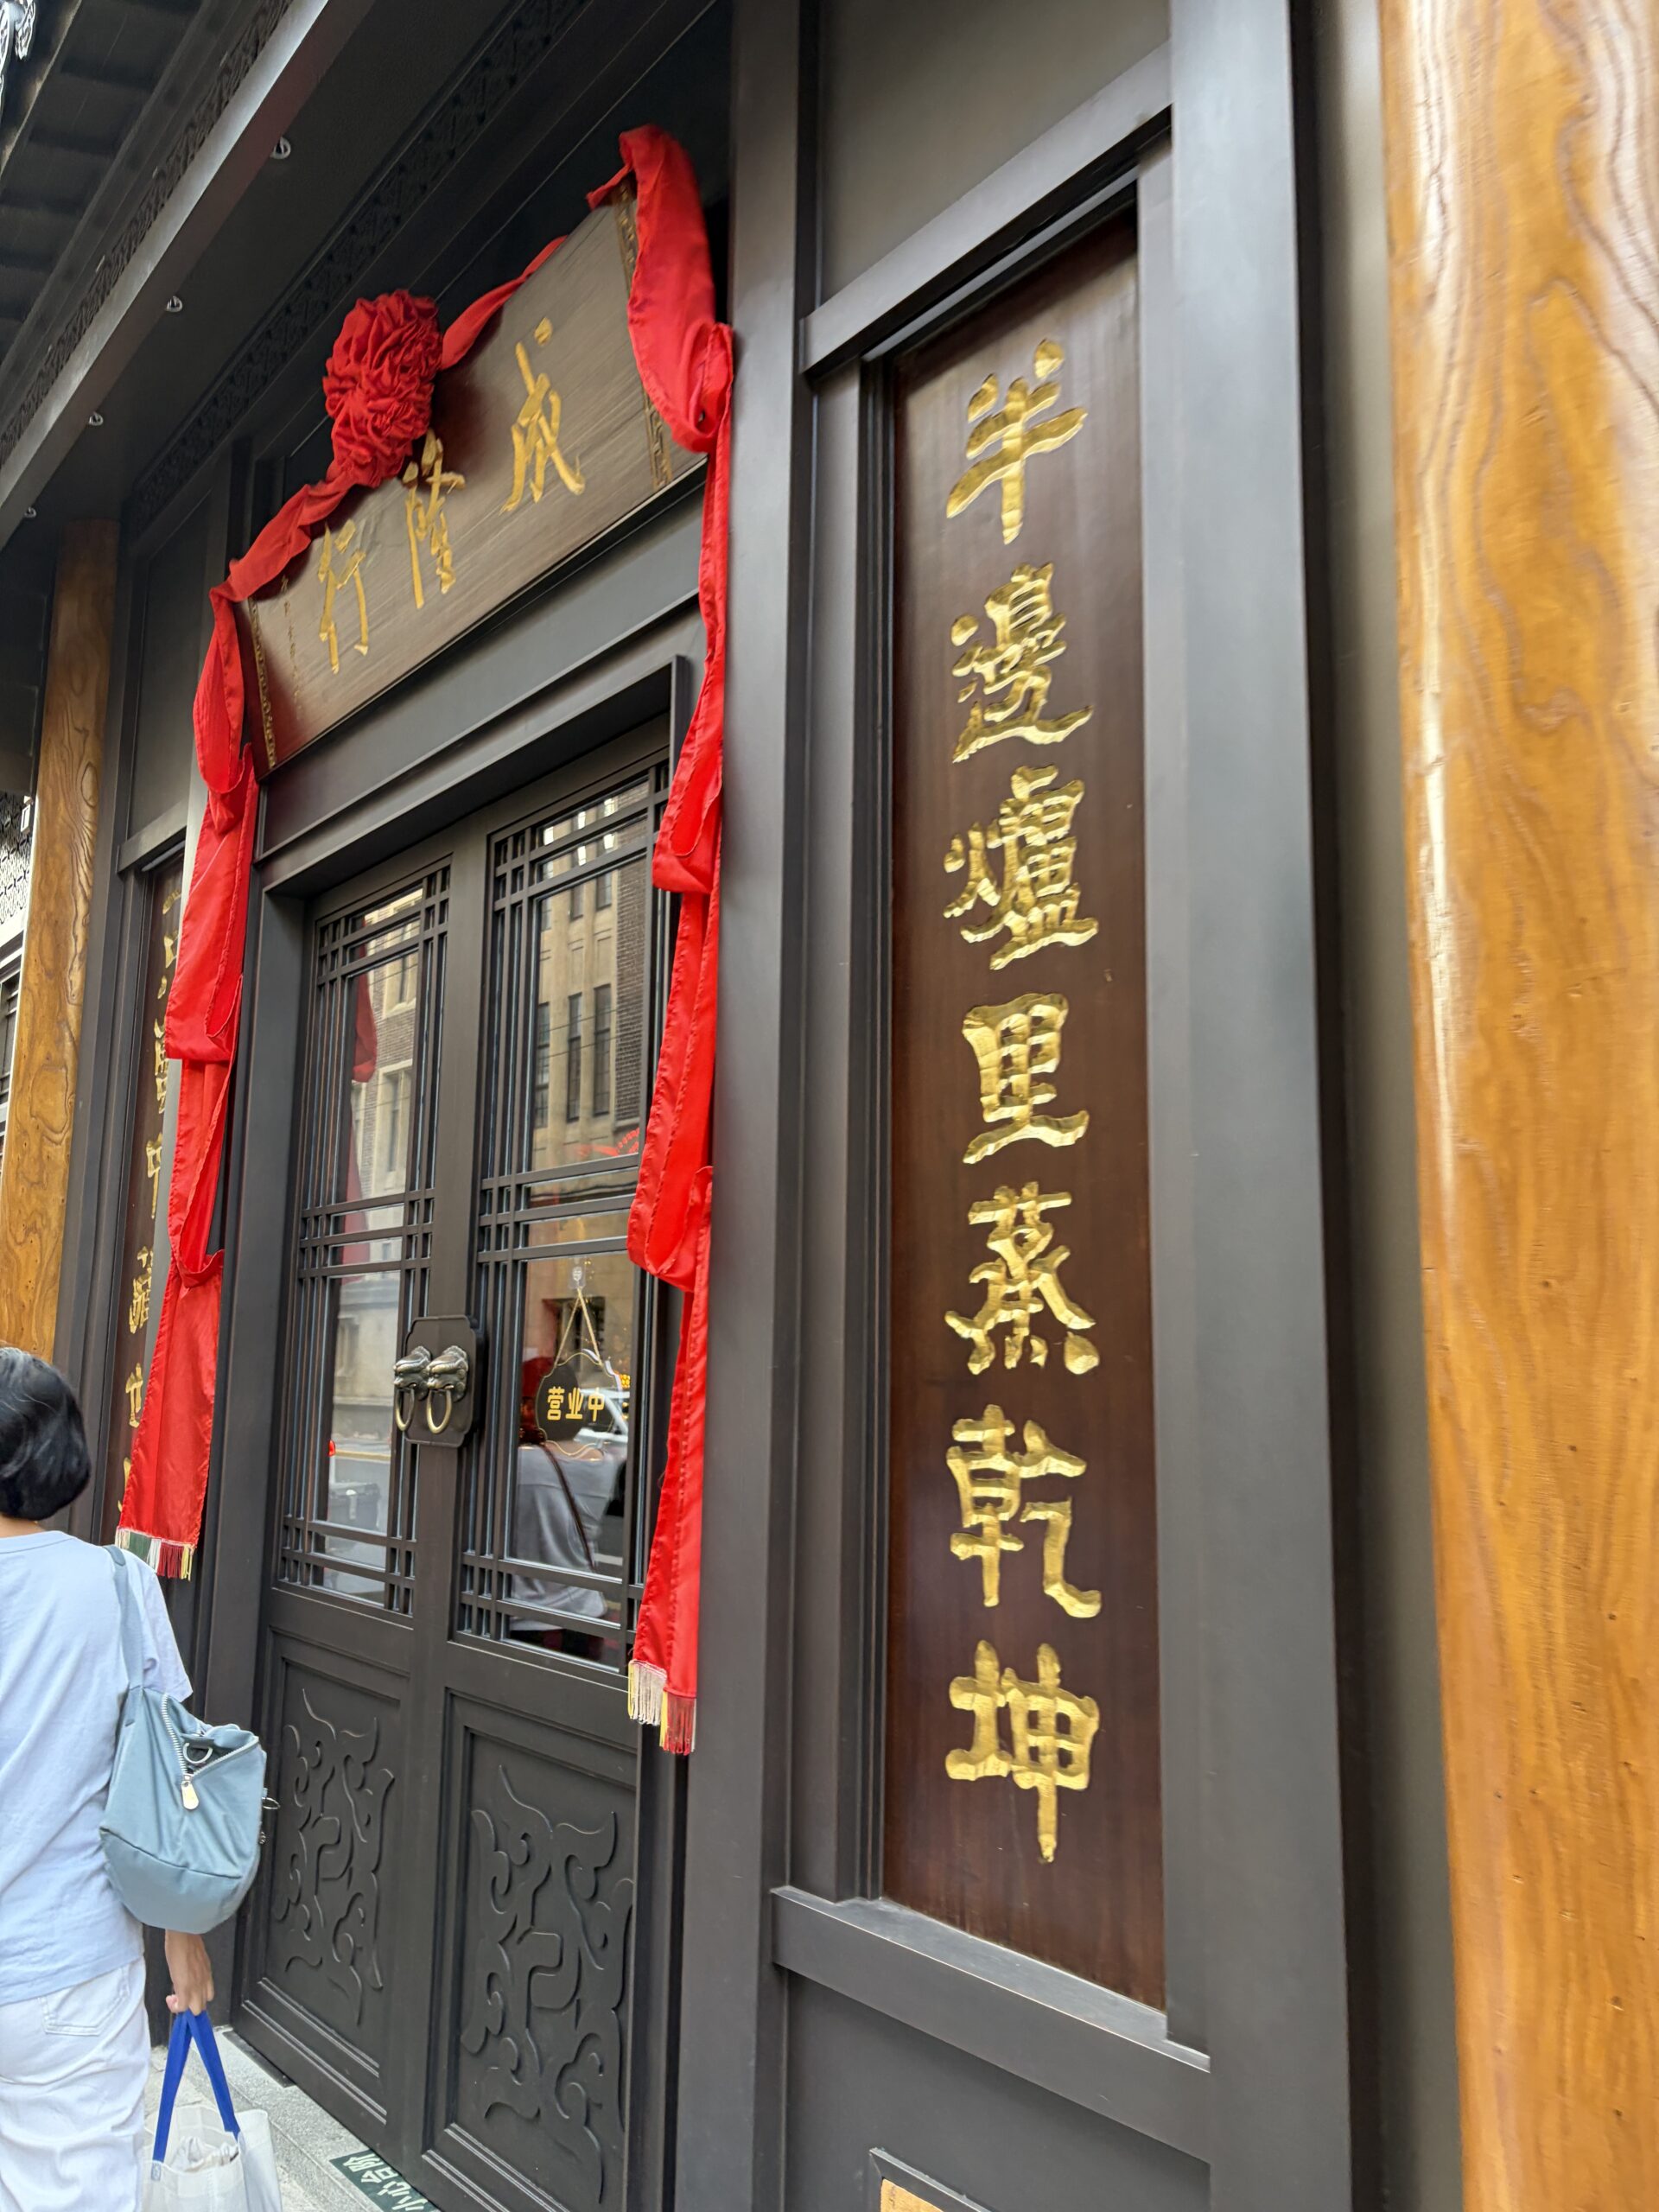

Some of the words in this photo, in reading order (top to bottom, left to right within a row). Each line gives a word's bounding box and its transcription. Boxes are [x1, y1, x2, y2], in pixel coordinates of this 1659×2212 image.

[547, 1386, 605, 1422] 营业中
[344, 2153, 429, 2211] 小心台阶
